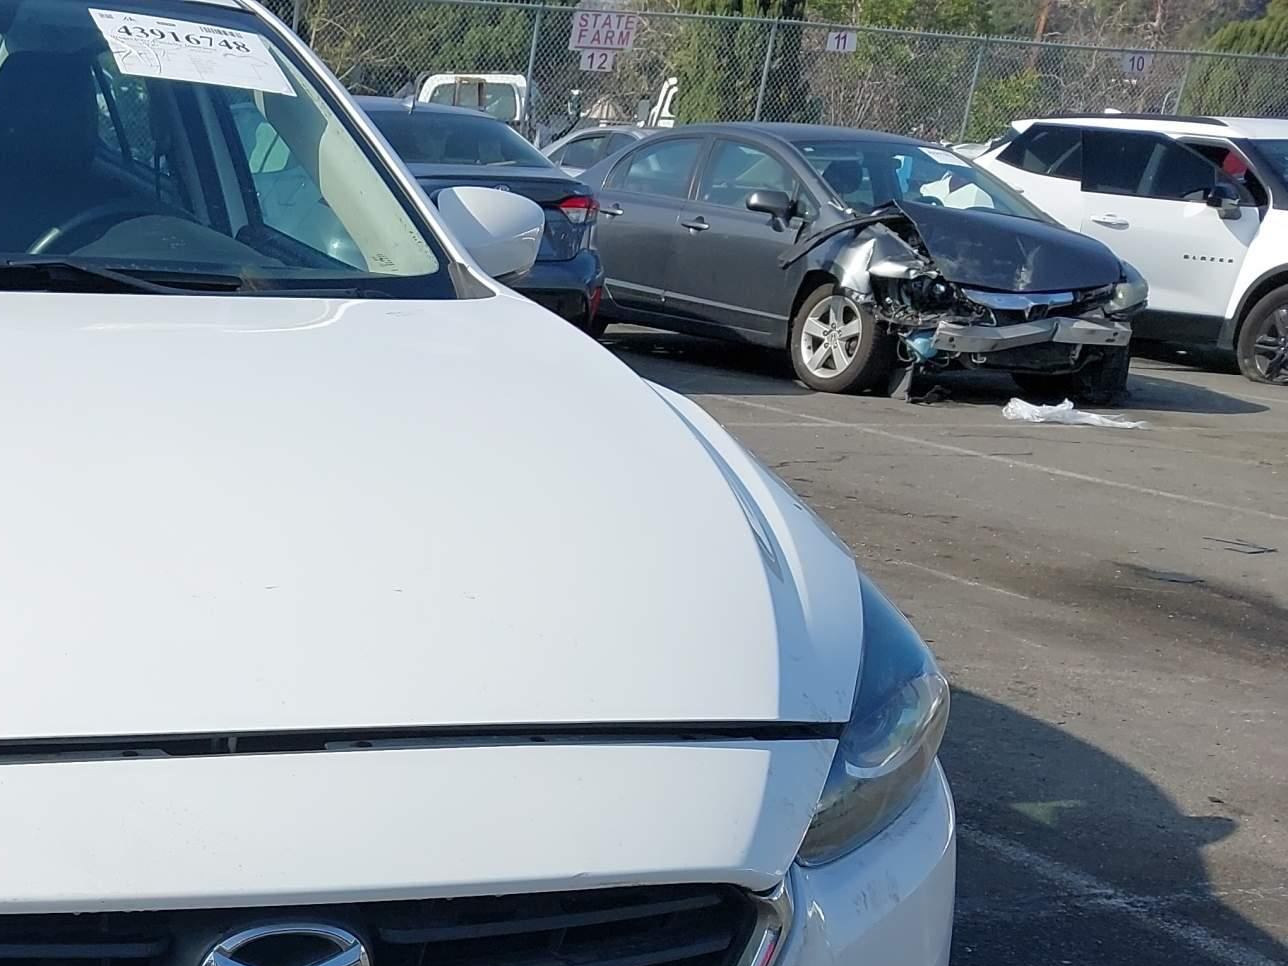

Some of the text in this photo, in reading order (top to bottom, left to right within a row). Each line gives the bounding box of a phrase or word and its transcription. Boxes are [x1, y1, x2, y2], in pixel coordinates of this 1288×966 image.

[579, 14, 637, 30] STATE
[117, 24, 250, 53] 43916748
[578, 30, 631, 46] FARM
[835, 34, 848, 49] 11
[587, 53, 608, 70] 12
[1129, 55, 1145, 72] 10
